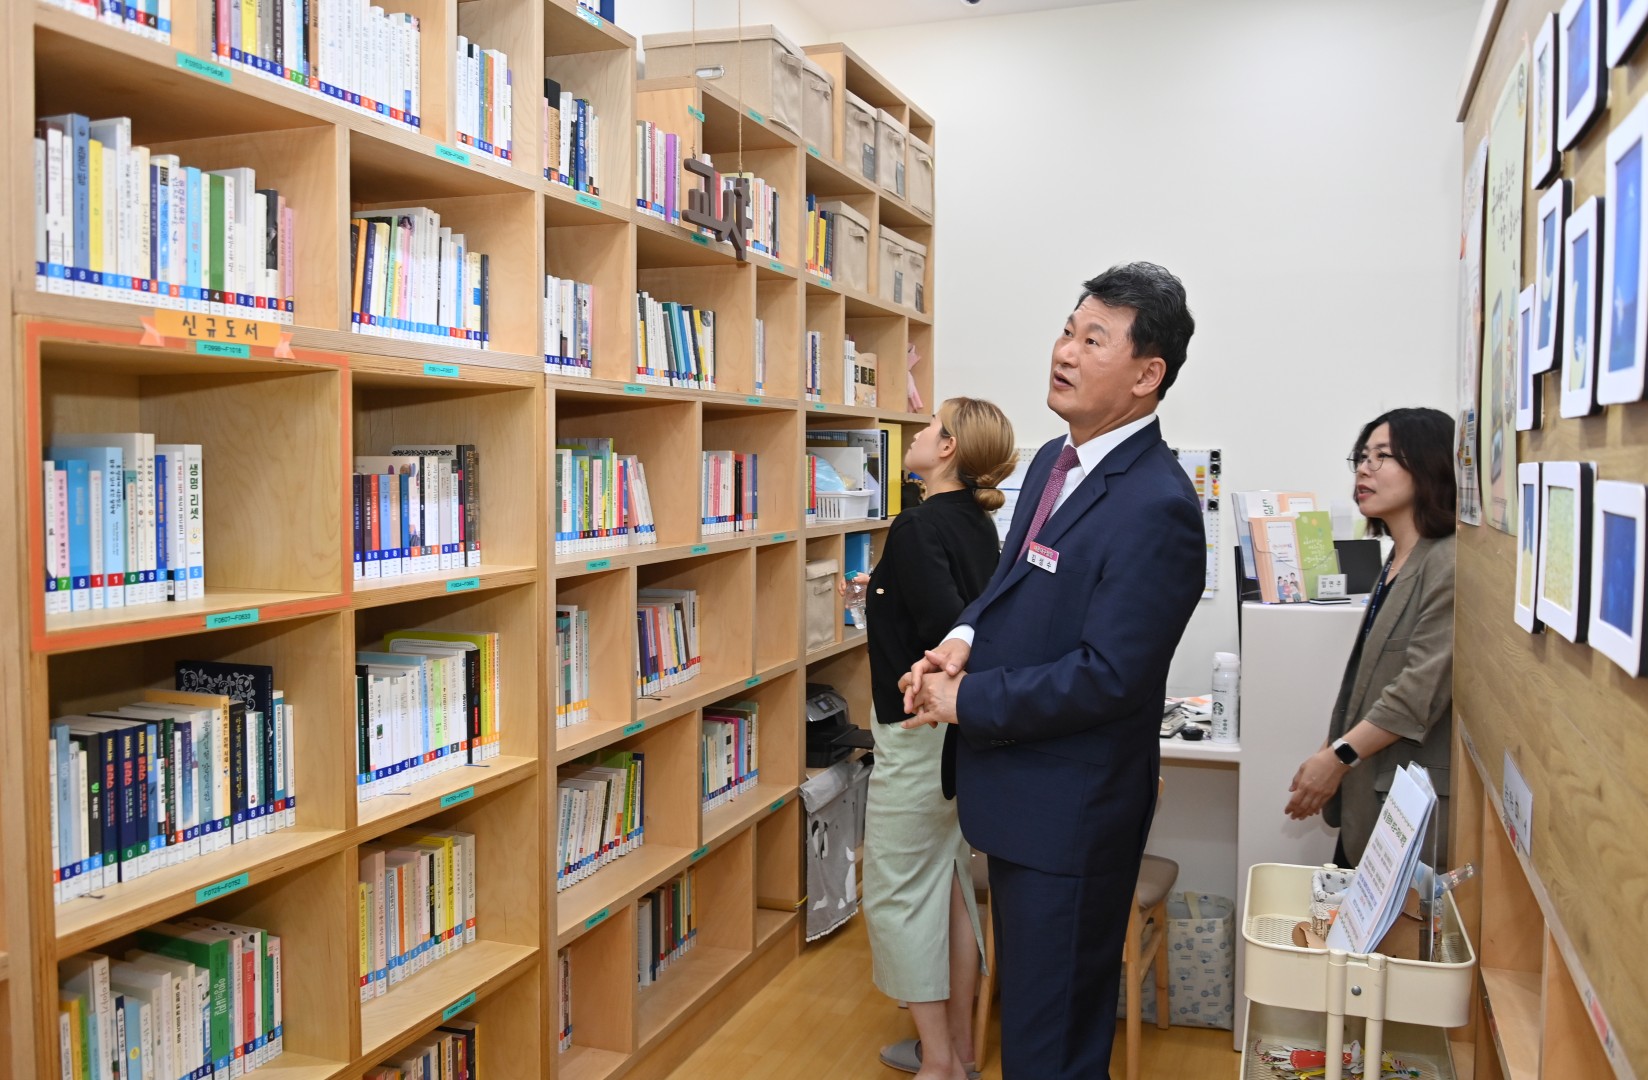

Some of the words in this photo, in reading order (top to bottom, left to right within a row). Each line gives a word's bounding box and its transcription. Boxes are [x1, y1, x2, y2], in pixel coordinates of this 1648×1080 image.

[182, 315, 258, 340] 신규도서
[190, 464, 198, 490] 생명
[190, 494, 199, 520] 리셋
[148, 572, 154, 580] 8
[179, 570, 185, 579] 5
[194, 568, 199, 576] 5
[96, 577, 101, 585] 1
[114, 576, 118, 584] 1
[130, 574, 136, 582] 0
[139, 573, 144, 581] 8
[50, 580, 56, 590] 8
[62, 579, 68, 588] 7
[79, 578, 85, 587] 8
[260, 806, 265, 815] 8
[269, 804, 274, 812] 8
[238, 813, 242, 821] 8
[251, 810, 256, 818] 8
[217, 821, 222, 829] 8
[224, 818, 230, 826] 0
[194, 827, 199, 836] 8
[205, 824, 210, 832] 8
[187, 830, 192, 839] 8
[150, 840, 156, 848] 5
[141, 844, 146, 853] 0
[127, 849, 133, 858] 0
[108, 854, 114, 863] 0
[75, 864, 80, 874] 8
[83, 862, 88, 870] 5
[64, 868, 70, 878] 8
[100, 966, 109, 986] 나무
[100, 988, 109, 1014] 이야기
[249, 1043, 253, 1051] 8
[237, 1048, 242, 1056] 3
[219, 1059, 224, 1067] 5
[206, 1065, 211, 1074] 8
[192, 1072, 197, 1080] 8
